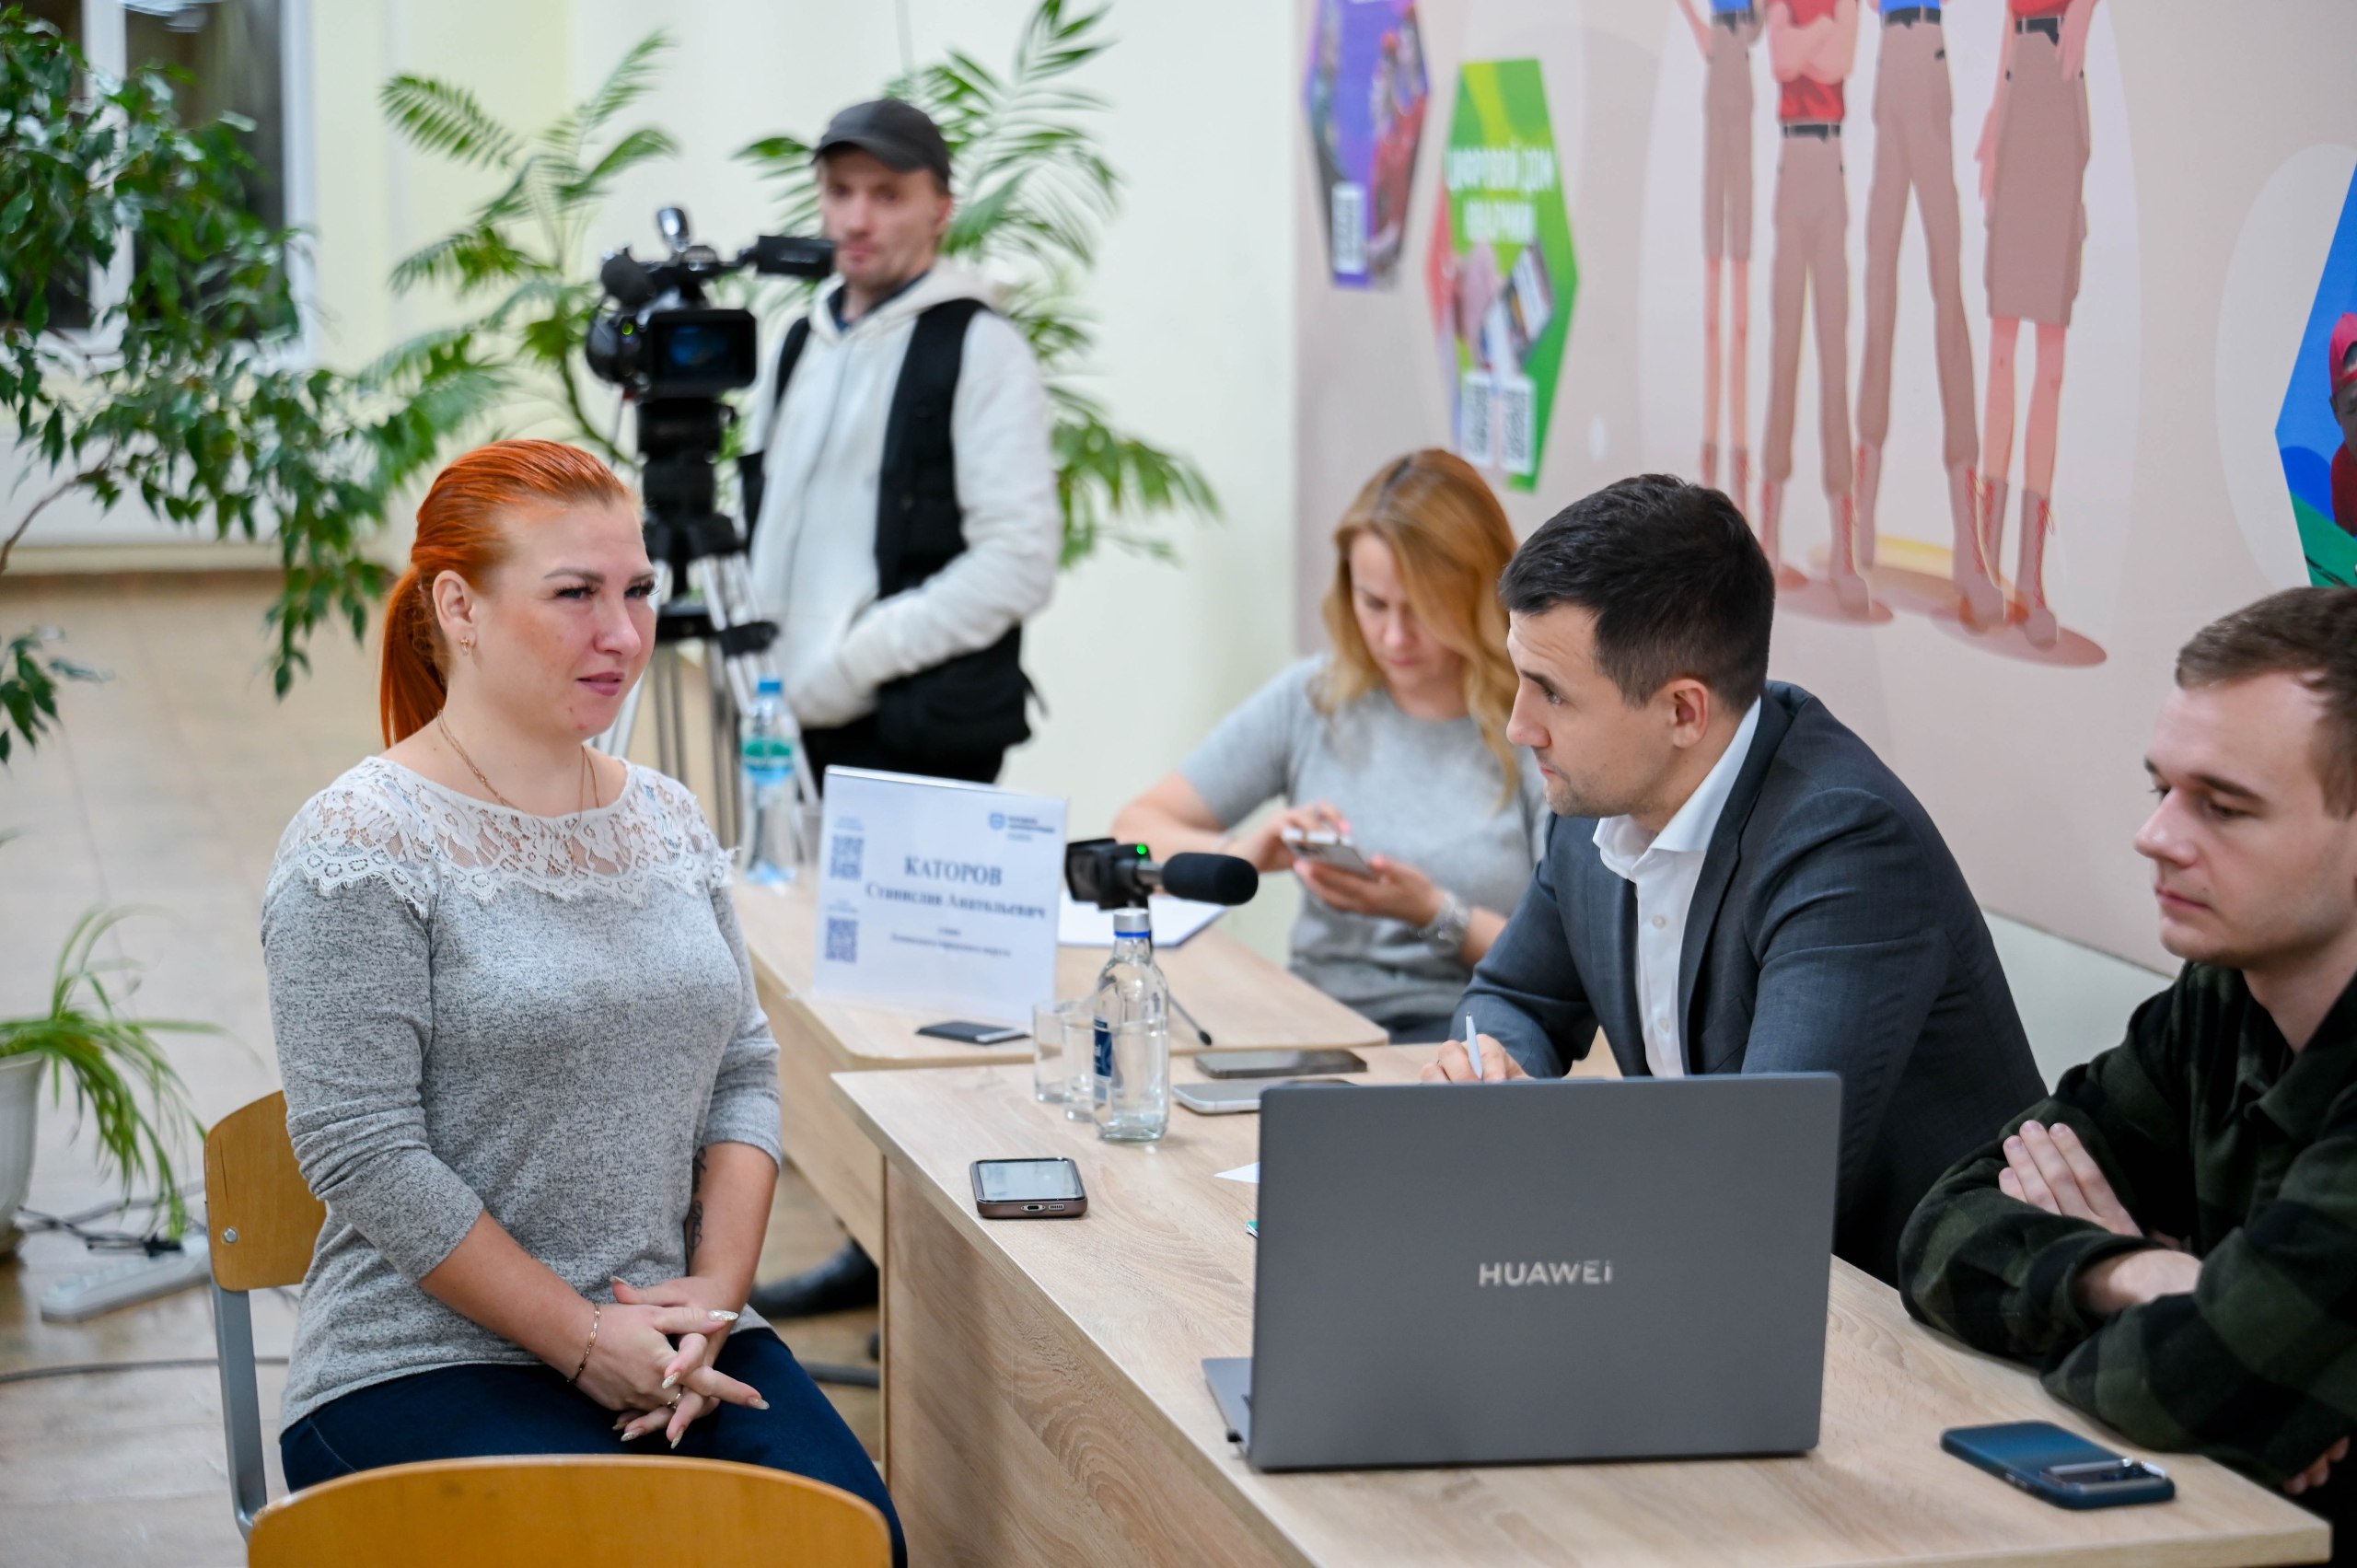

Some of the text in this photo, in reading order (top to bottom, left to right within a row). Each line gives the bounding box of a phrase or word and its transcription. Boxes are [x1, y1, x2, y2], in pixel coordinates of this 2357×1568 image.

[903, 855, 1003, 887] КАТОРОВ
[865, 882, 943, 907] Станислав
[947, 893, 1046, 919] Анатольевич
[1478, 1260, 1613, 1287] HUAWEI
